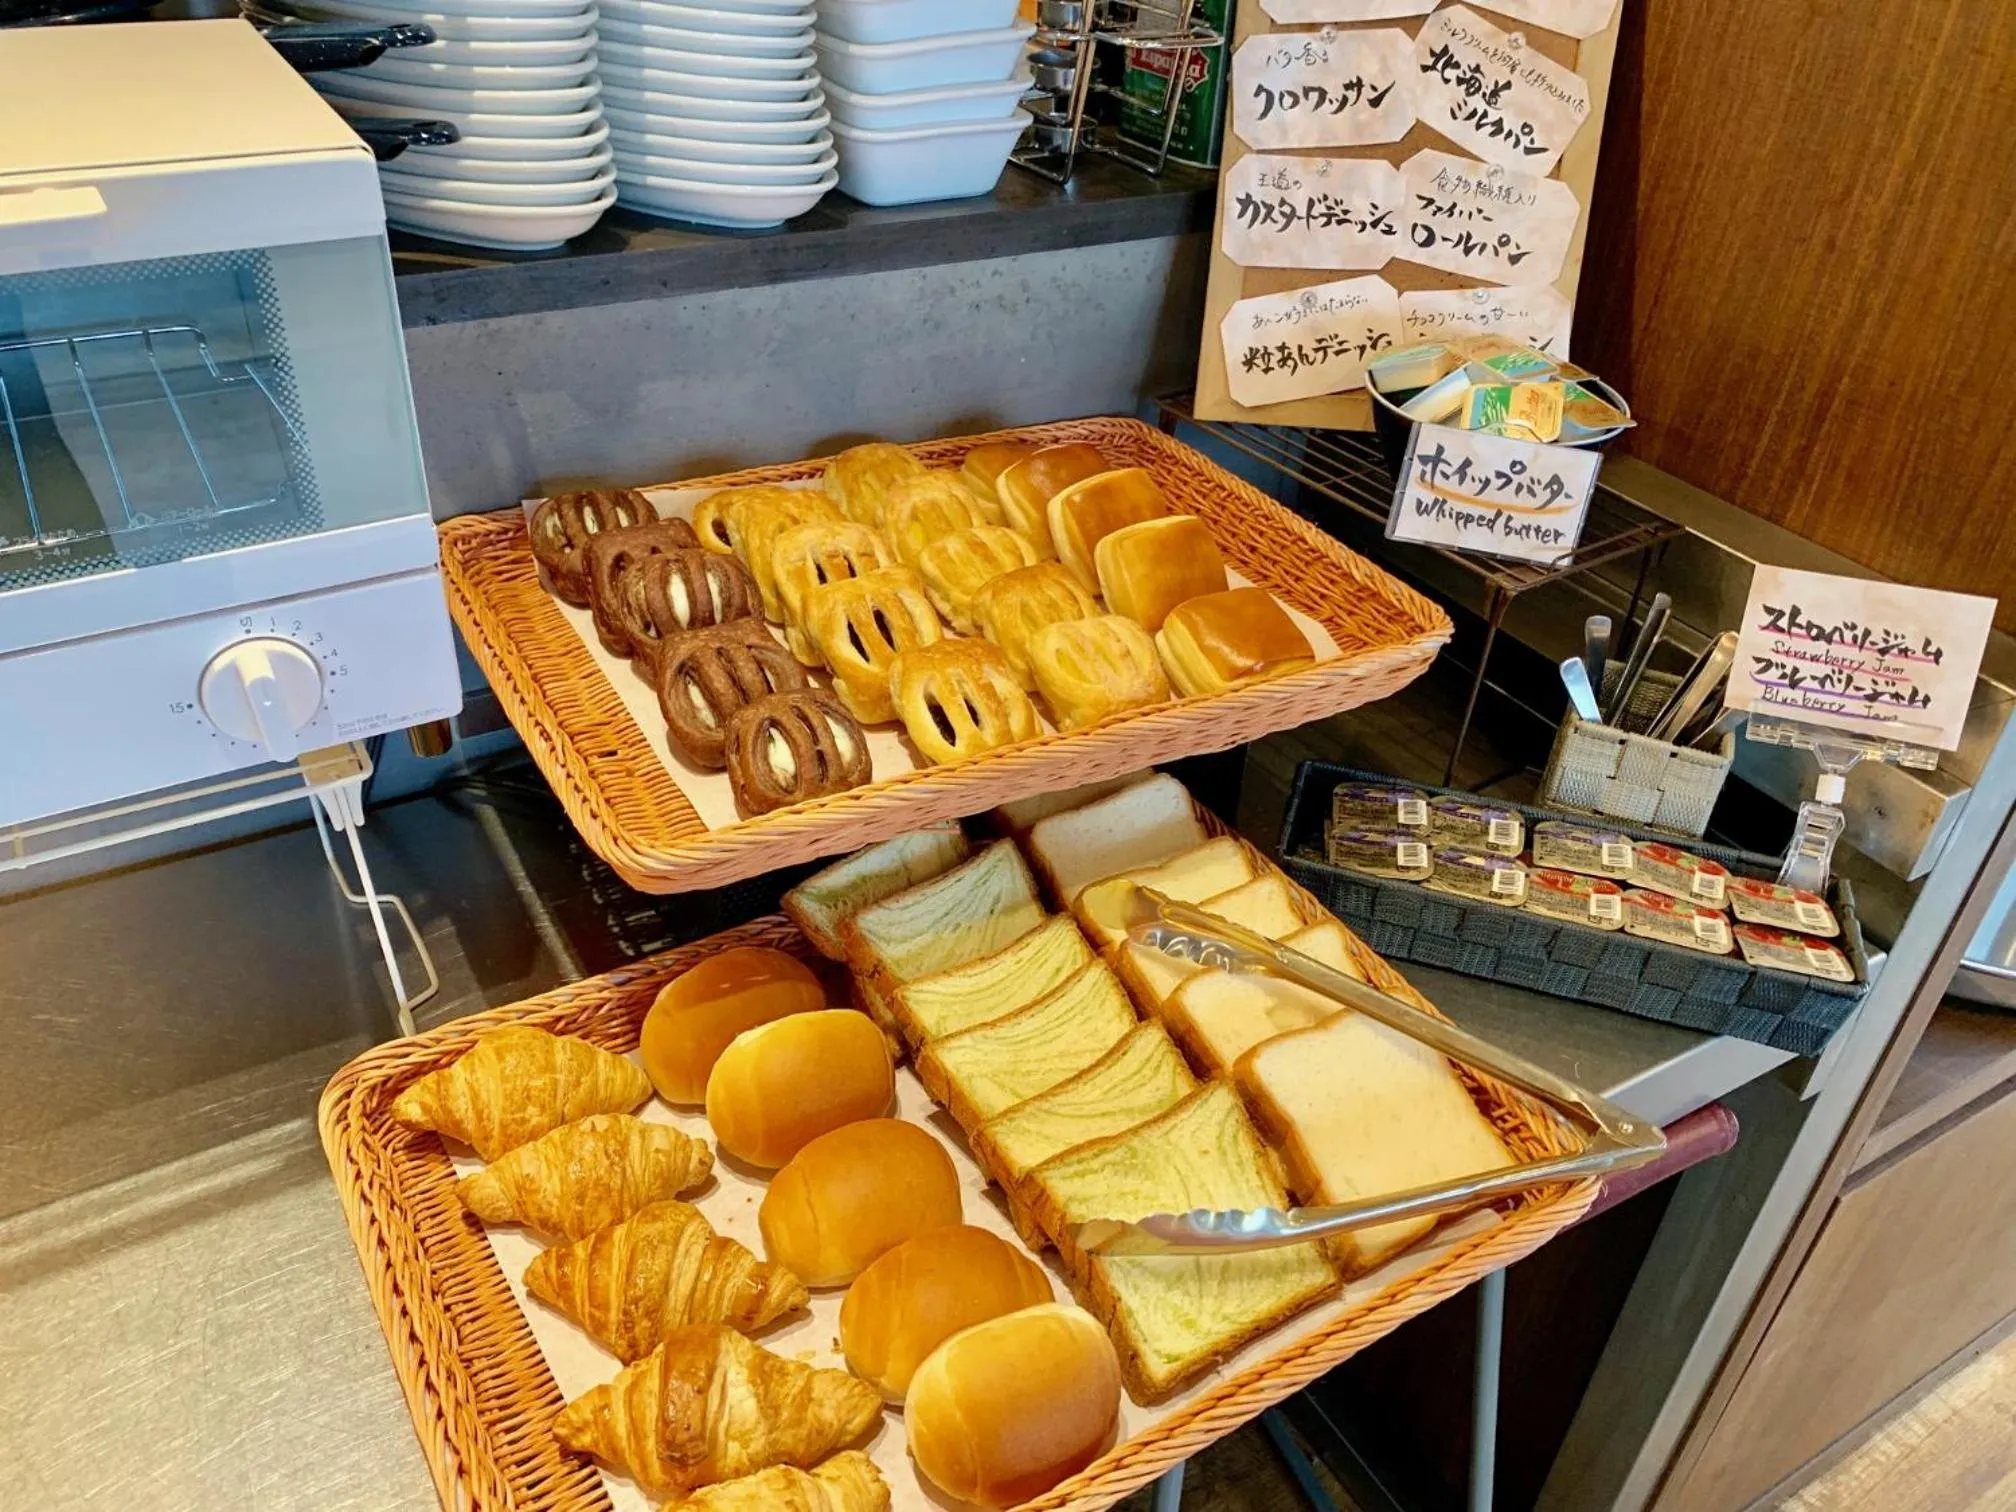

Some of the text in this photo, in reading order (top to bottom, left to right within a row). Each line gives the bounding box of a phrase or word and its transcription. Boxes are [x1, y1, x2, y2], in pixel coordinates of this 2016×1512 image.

[1420, 43, 1513, 111] 北海道
[1253, 75, 1396, 121] クロワッサン
[1449, 98, 1551, 156] ミルクパン
[1257, 167, 1303, 191] 王道の
[1235, 192, 1398, 236] カスタードデニッシュ
[1415, 193, 1494, 222] ファイバー
[1410, 222, 1535, 267] ロールパン
[1503, 515, 1566, 545] butter
[292, 620, 302, 631] 2
[315, 632, 324, 643] 3
[1761, 603, 1944, 666] ストロベリージャム
[339, 665, 348, 677] 5
[1771, 639, 1905, 675] Strawberry Jam
[1751, 655, 1933, 710] ブルーベリージャム
[169, 701, 186, 714] 15
[1863, 704, 1900, 722] Jam
